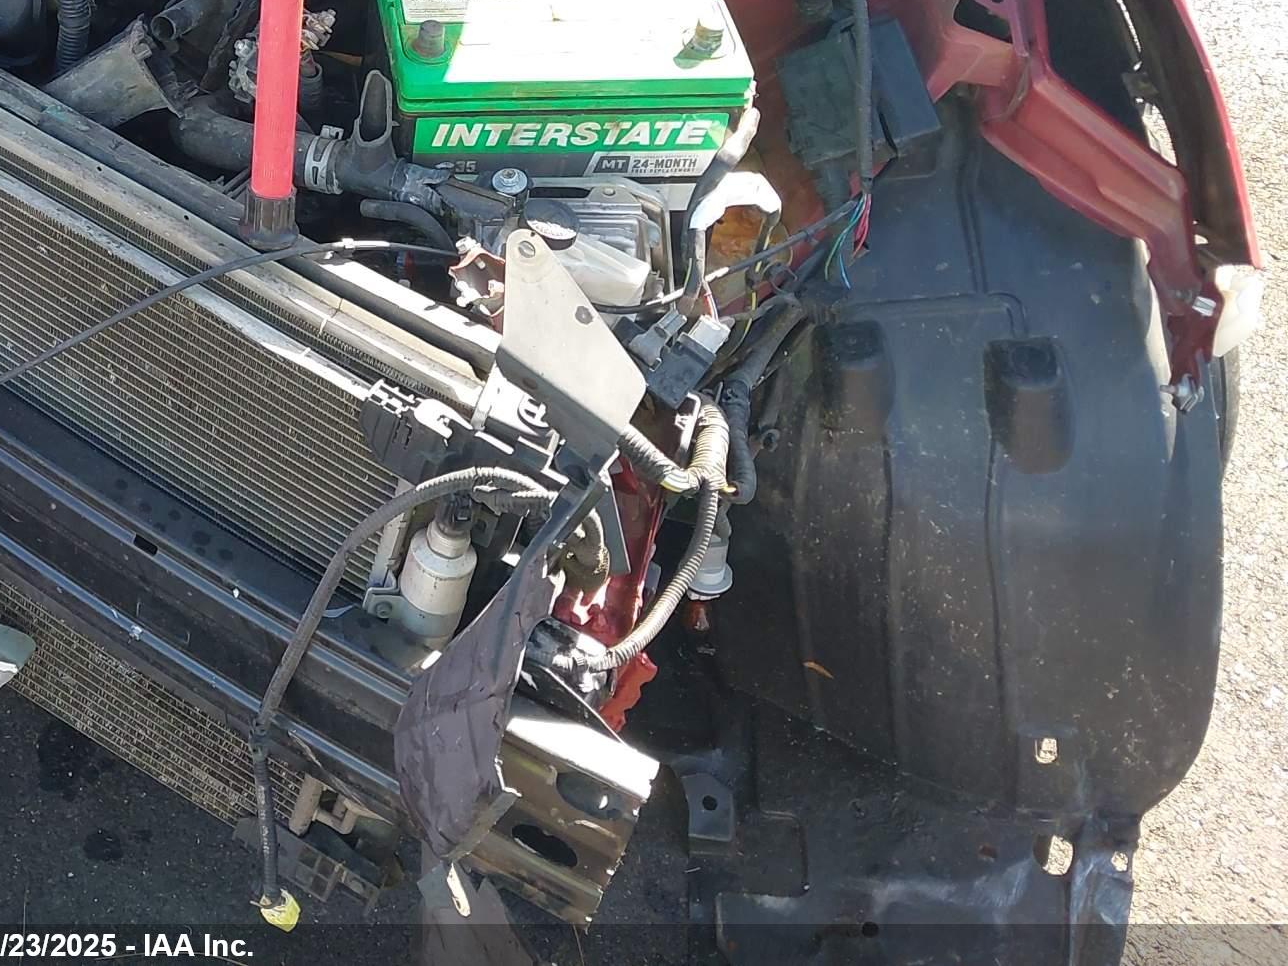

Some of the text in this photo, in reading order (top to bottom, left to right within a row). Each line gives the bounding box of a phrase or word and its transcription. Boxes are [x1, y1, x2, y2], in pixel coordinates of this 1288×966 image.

[431, 120, 712, 147] INTERSTATE
[602, 159, 626, 170] MT
[632, 158, 698, 169] 24-MONTH
